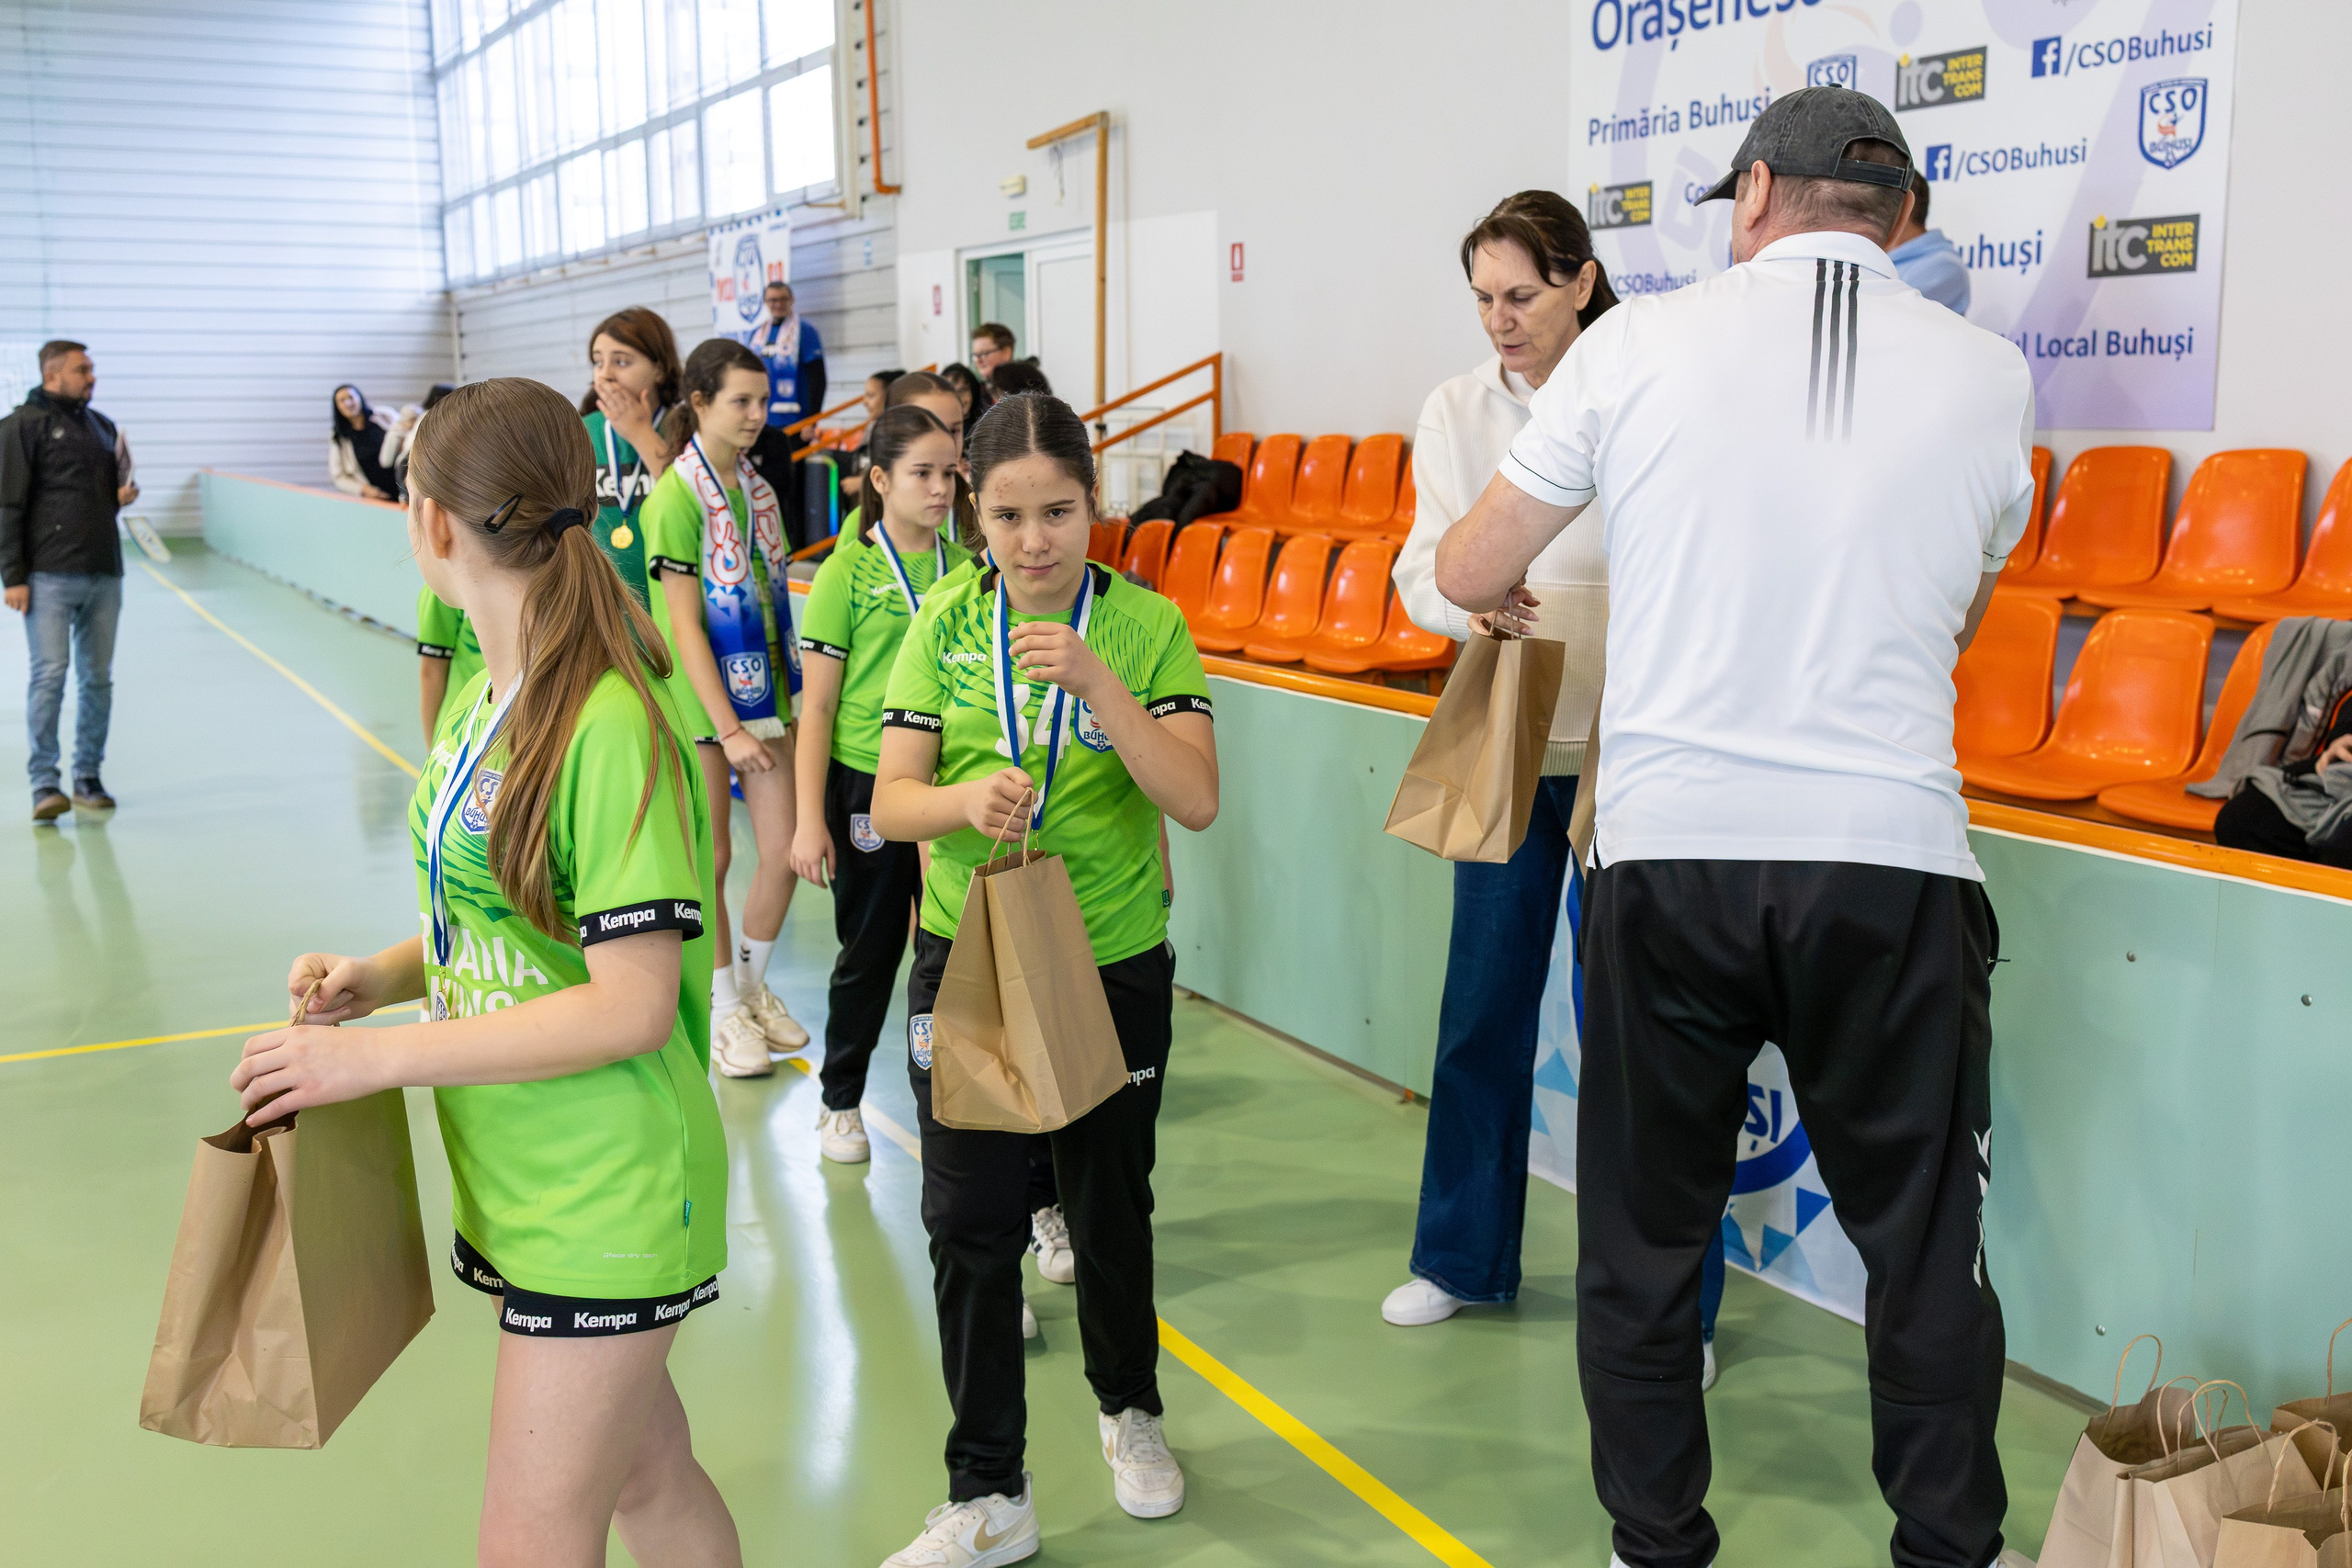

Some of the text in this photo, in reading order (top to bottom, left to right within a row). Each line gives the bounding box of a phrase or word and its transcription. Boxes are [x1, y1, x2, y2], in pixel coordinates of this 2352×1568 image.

[2064, 22, 2213, 77] /CSOBuhusi
[1947, 52, 1984, 73] INTER
[1942, 68, 1984, 88] TRANS
[1953, 82, 1983, 99] COM
[2149, 87, 2198, 115] CSO
[1589, 105, 1680, 147] Primăria
[1954, 137, 2087, 183] /CSOBuhusi
[2151, 220, 2196, 239] INTER
[1958, 229, 2042, 276] uhuși
[2146, 237, 2195, 255] TRANS
[2159, 251, 2194, 269] COM
[2036, 328, 2097, 358] Local
[2107, 326, 2194, 361] Buhuși
[729, 658, 762, 674] CSO
[943, 651, 988, 663] Kempa
[995, 683, 1072, 759] 34
[480, 778, 499, 796] CS
[599, 908, 657, 932] Kempa
[473, 1267, 503, 1288] Kem
[505, 1279, 718, 1332] Kempa Kempa Kempa Kempa
